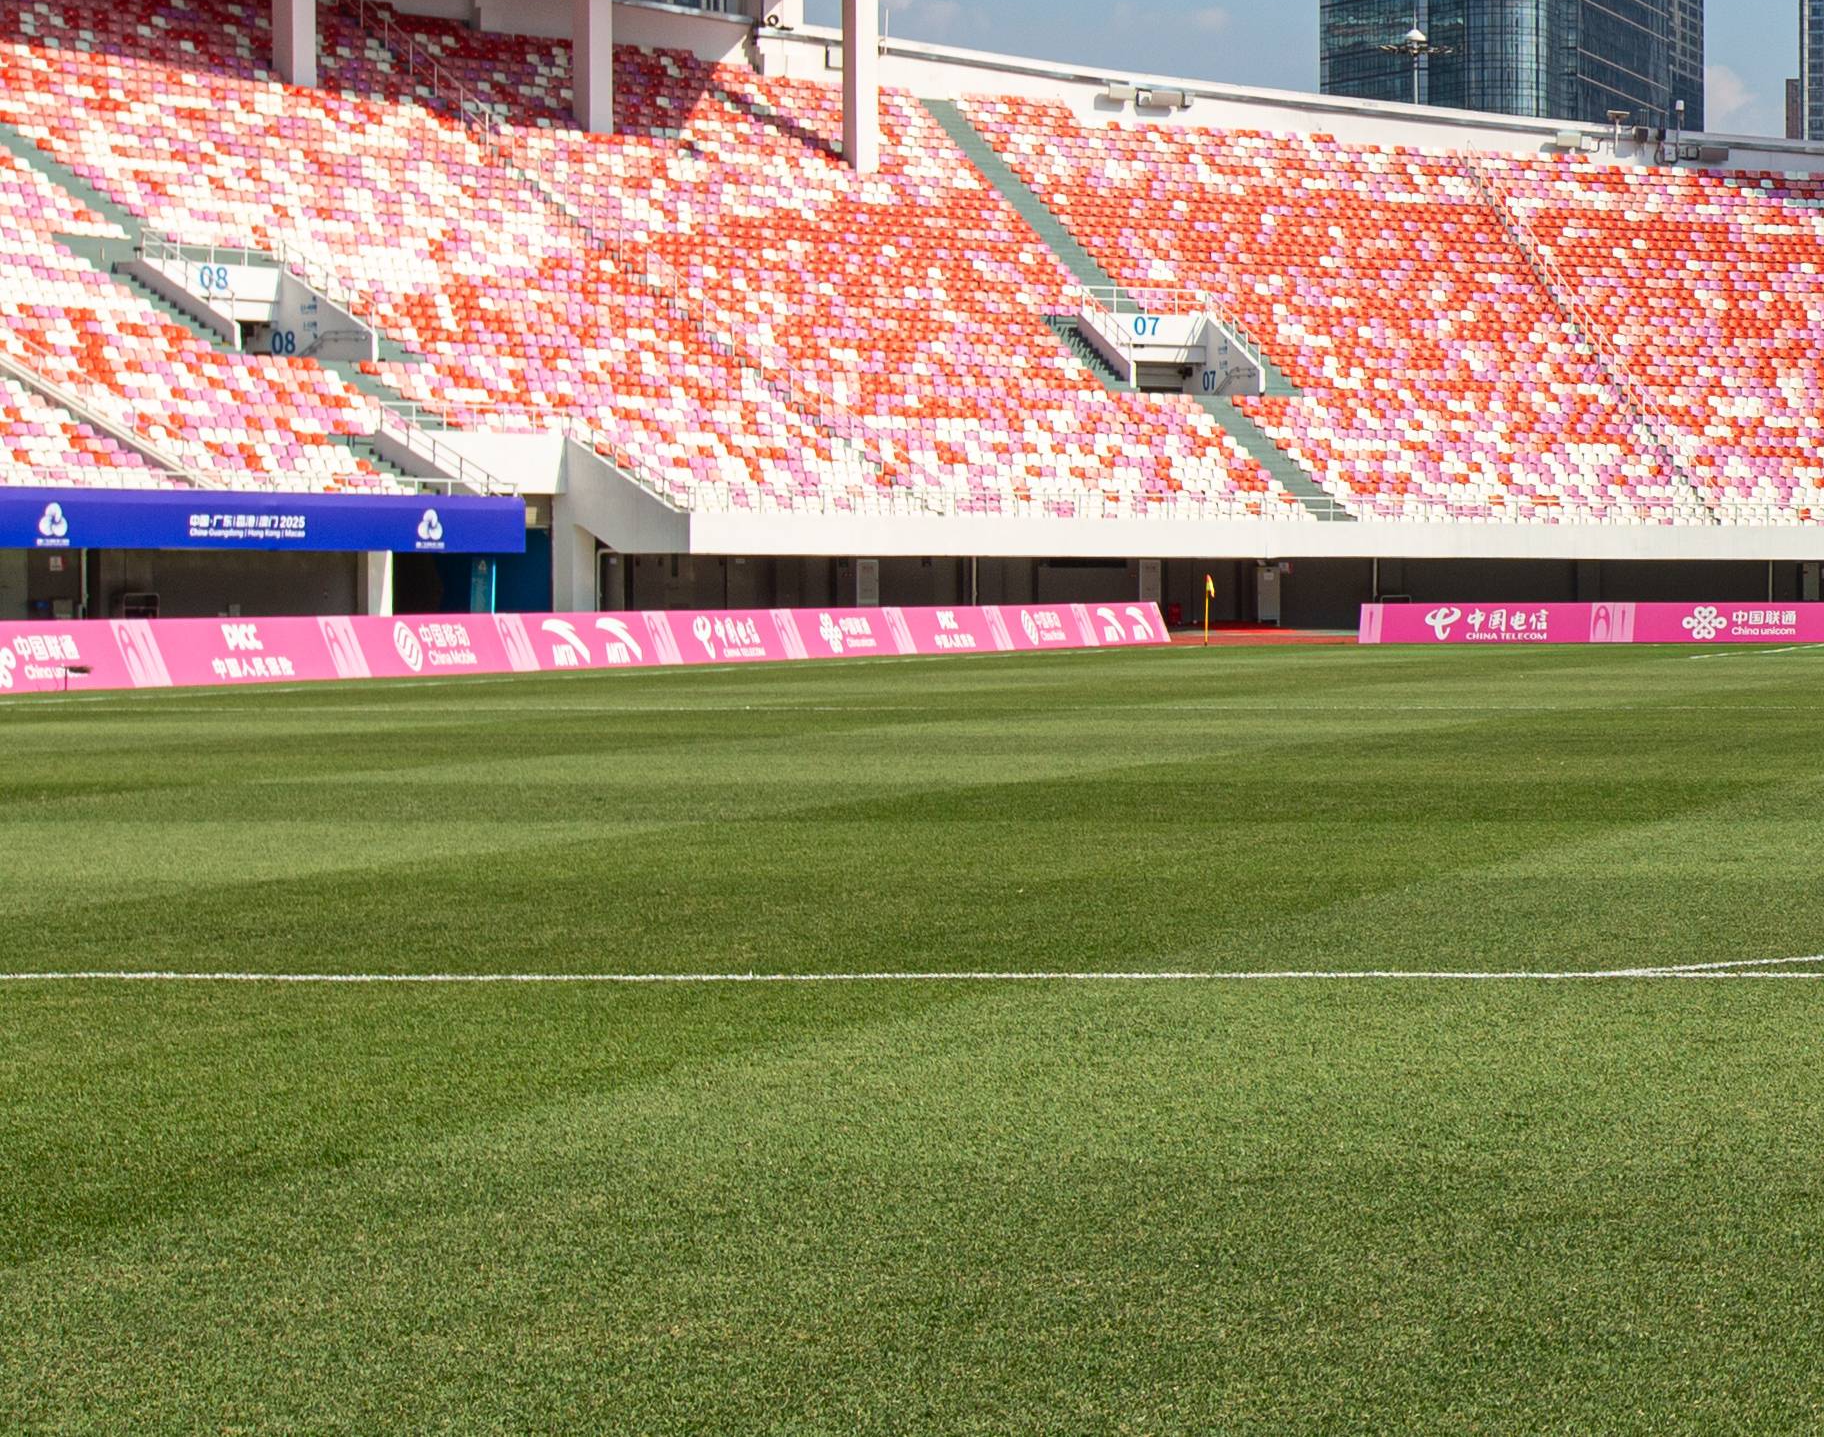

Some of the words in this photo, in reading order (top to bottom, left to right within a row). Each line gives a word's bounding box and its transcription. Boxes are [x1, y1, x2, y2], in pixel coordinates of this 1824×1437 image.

[200, 266, 228, 290] 08
[1134, 317, 1160, 336] 07
[272, 331, 296, 354] 08
[1202, 370, 1216, 391] 07
[280, 516, 305, 529] 2025
[1466, 608, 1548, 631] 中国电信
[1732, 610, 1796, 625] 中国联通
[221, 624, 263, 651] PICC
[418, 623, 470, 647] 中国移动
[1466, 632, 1498, 640] CHINA
[1501, 632, 1547, 640] TELECOM
[1732, 626, 1759, 636] China
[1760, 626, 1796, 636] unicom
[12, 635, 80, 661] 中国联通
[428, 650, 450, 666] China
[450, 650, 478, 664] Mobile
[552, 644, 579, 667] ANTA
[605, 642, 631, 664] ANTA
[24, 664, 53, 679] China
[211, 656, 295, 679] 中国人民保险
